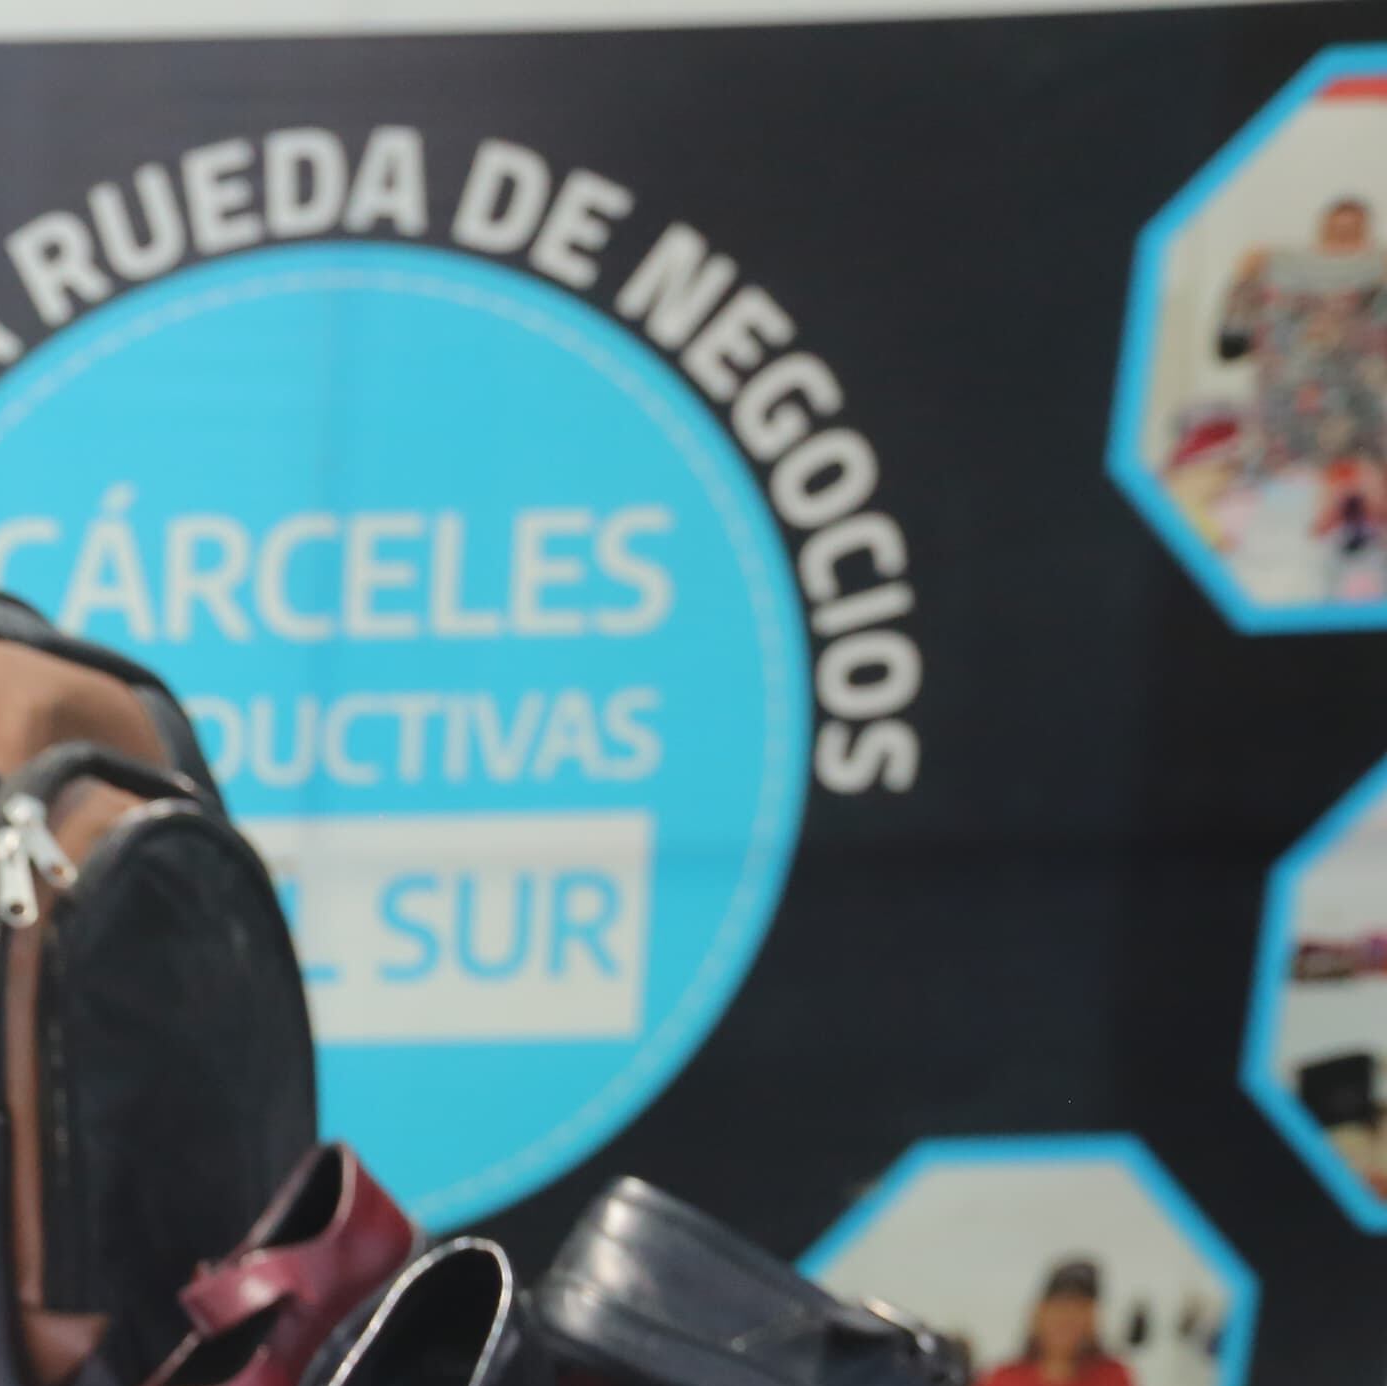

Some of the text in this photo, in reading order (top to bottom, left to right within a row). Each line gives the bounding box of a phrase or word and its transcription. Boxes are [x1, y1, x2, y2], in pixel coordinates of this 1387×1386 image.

[4, 124, 427, 326] RUEDA
[451, 140, 631, 288] DE
[618, 225, 921, 793] NEGOCIOS
[182, 688, 665, 786] DUCTIVAS
[376, 868, 625, 984] SUR
